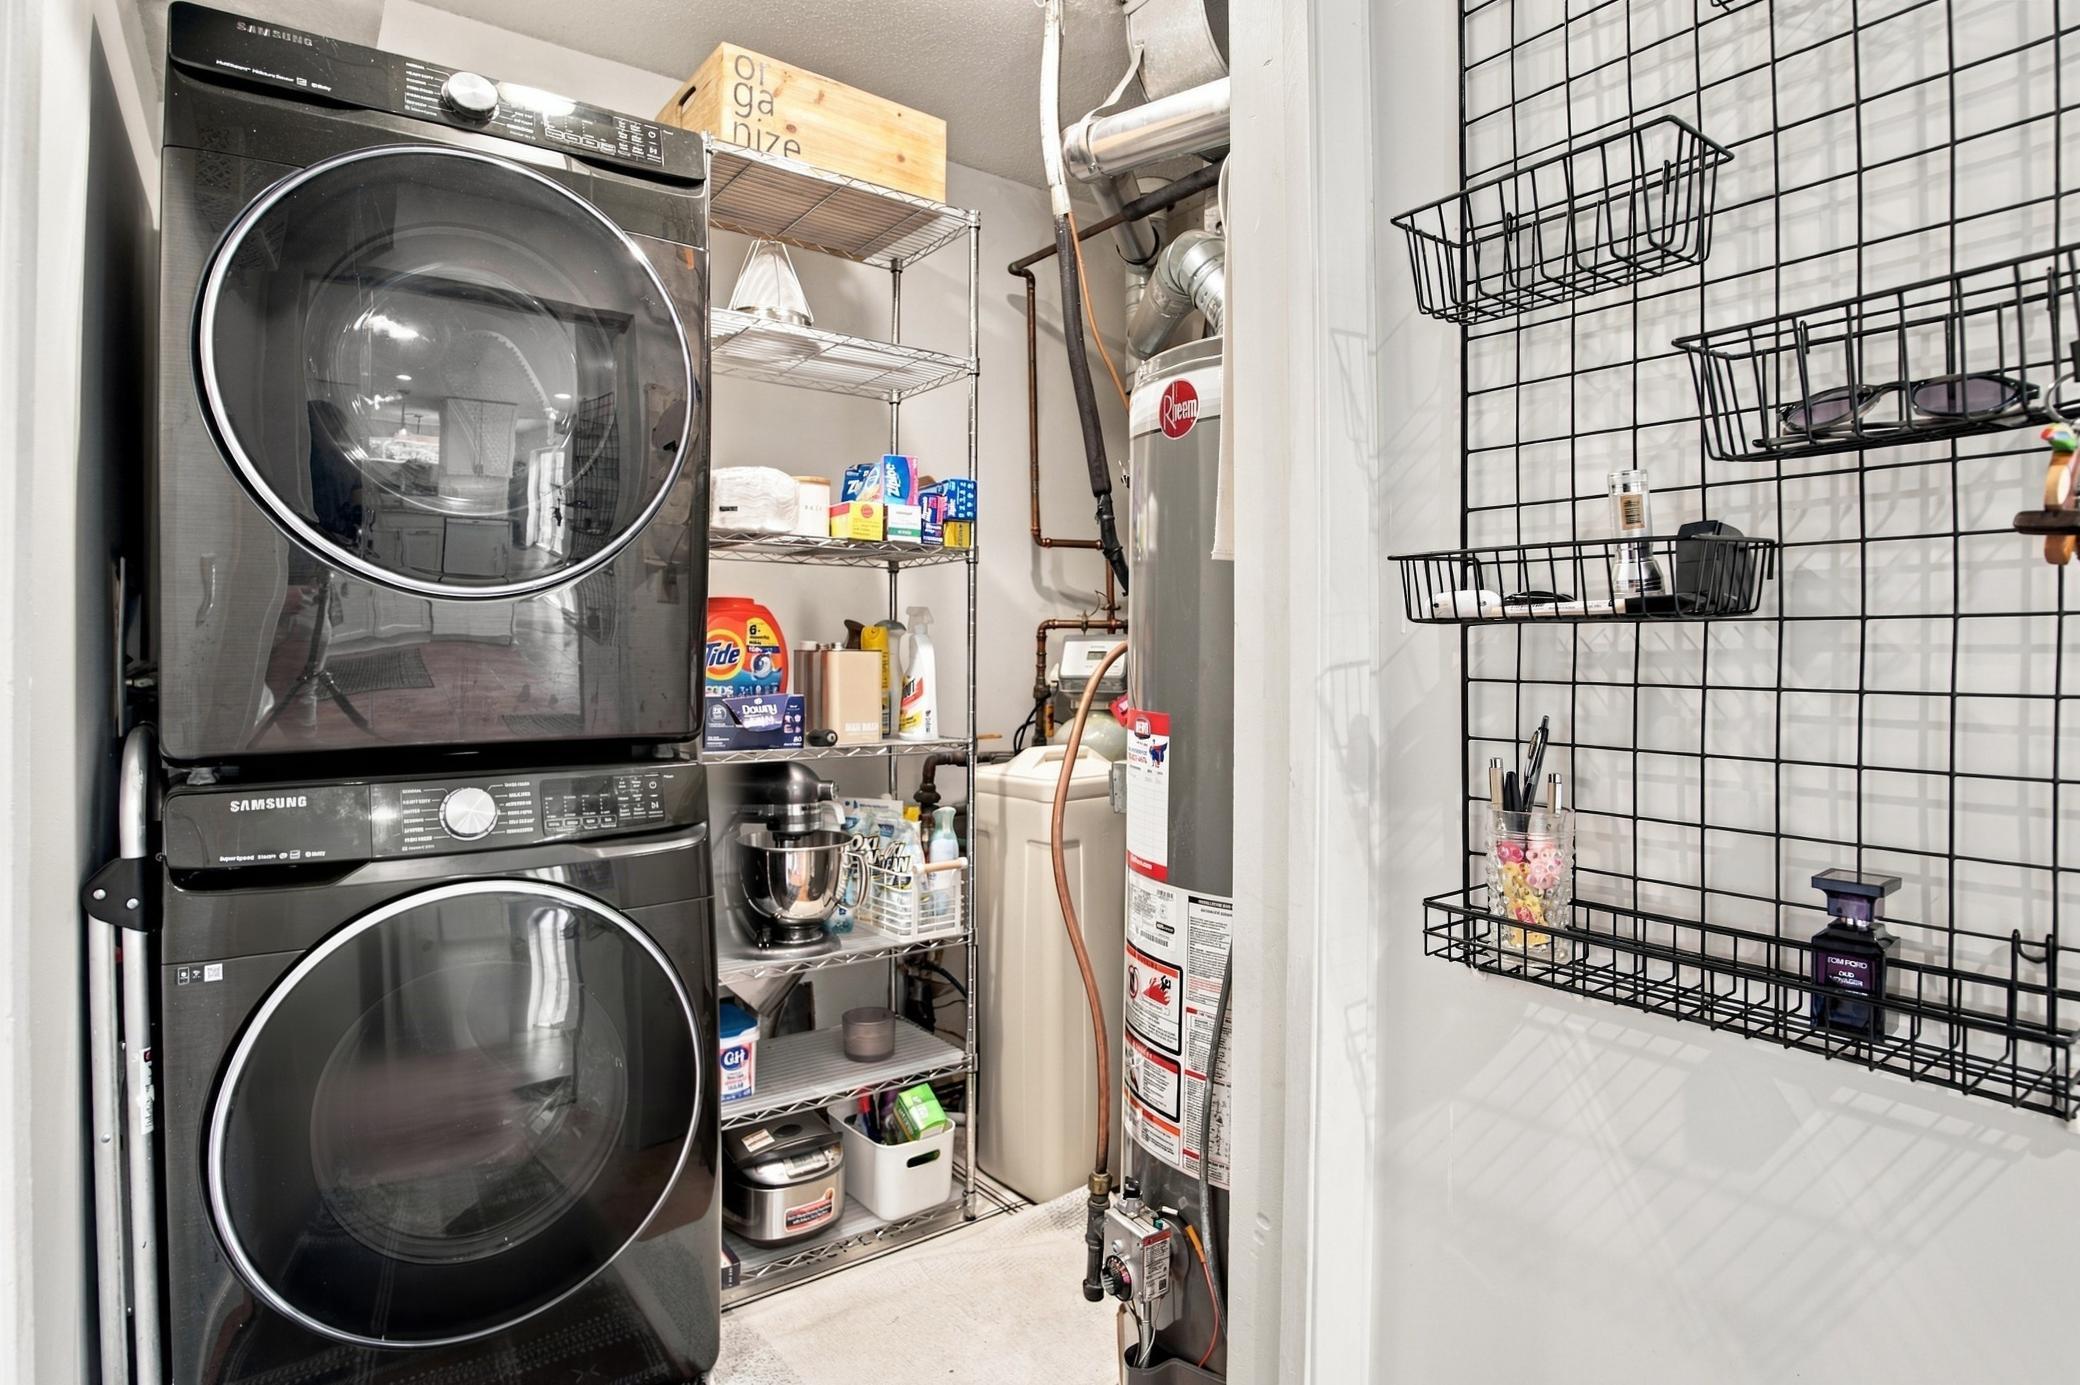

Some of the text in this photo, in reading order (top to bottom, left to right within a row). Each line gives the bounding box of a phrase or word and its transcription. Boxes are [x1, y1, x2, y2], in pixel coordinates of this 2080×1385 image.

[236, 20, 313, 47] SAMSUNG
[733, 82, 774, 118] ga
[1163, 382, 1197, 431] Rheem
[706, 642, 740, 667] Tide
[742, 704, 778, 715] Downy
[230, 795, 307, 813] SAMSUNG
[1827, 956, 1867, 969] TOM FORD
[1838, 970, 1855, 978] OUD
